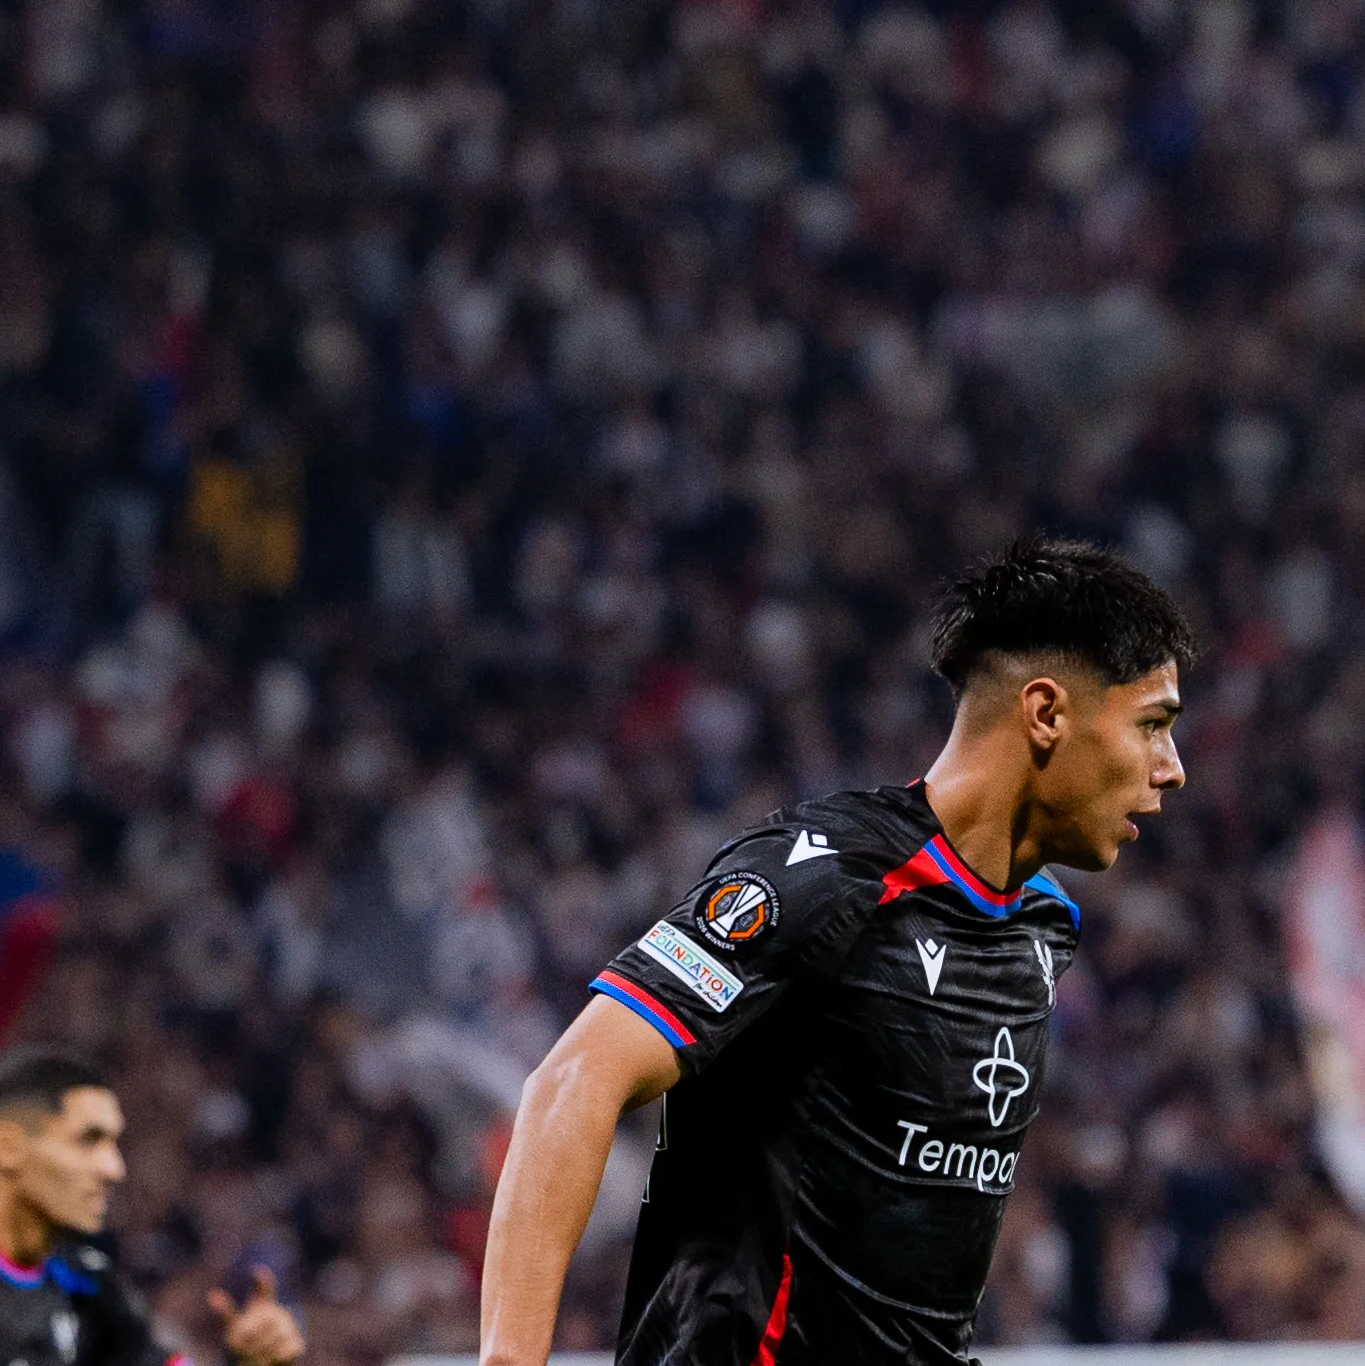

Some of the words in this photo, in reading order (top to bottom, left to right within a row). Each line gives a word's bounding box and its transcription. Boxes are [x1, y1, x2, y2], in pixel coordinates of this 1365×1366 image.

[719, 873, 737, 884] UEFA
[738, 872, 777, 897] CONFERENCE
[769, 899, 780, 927] LEAGUE
[705, 930, 735, 951] WINNERS
